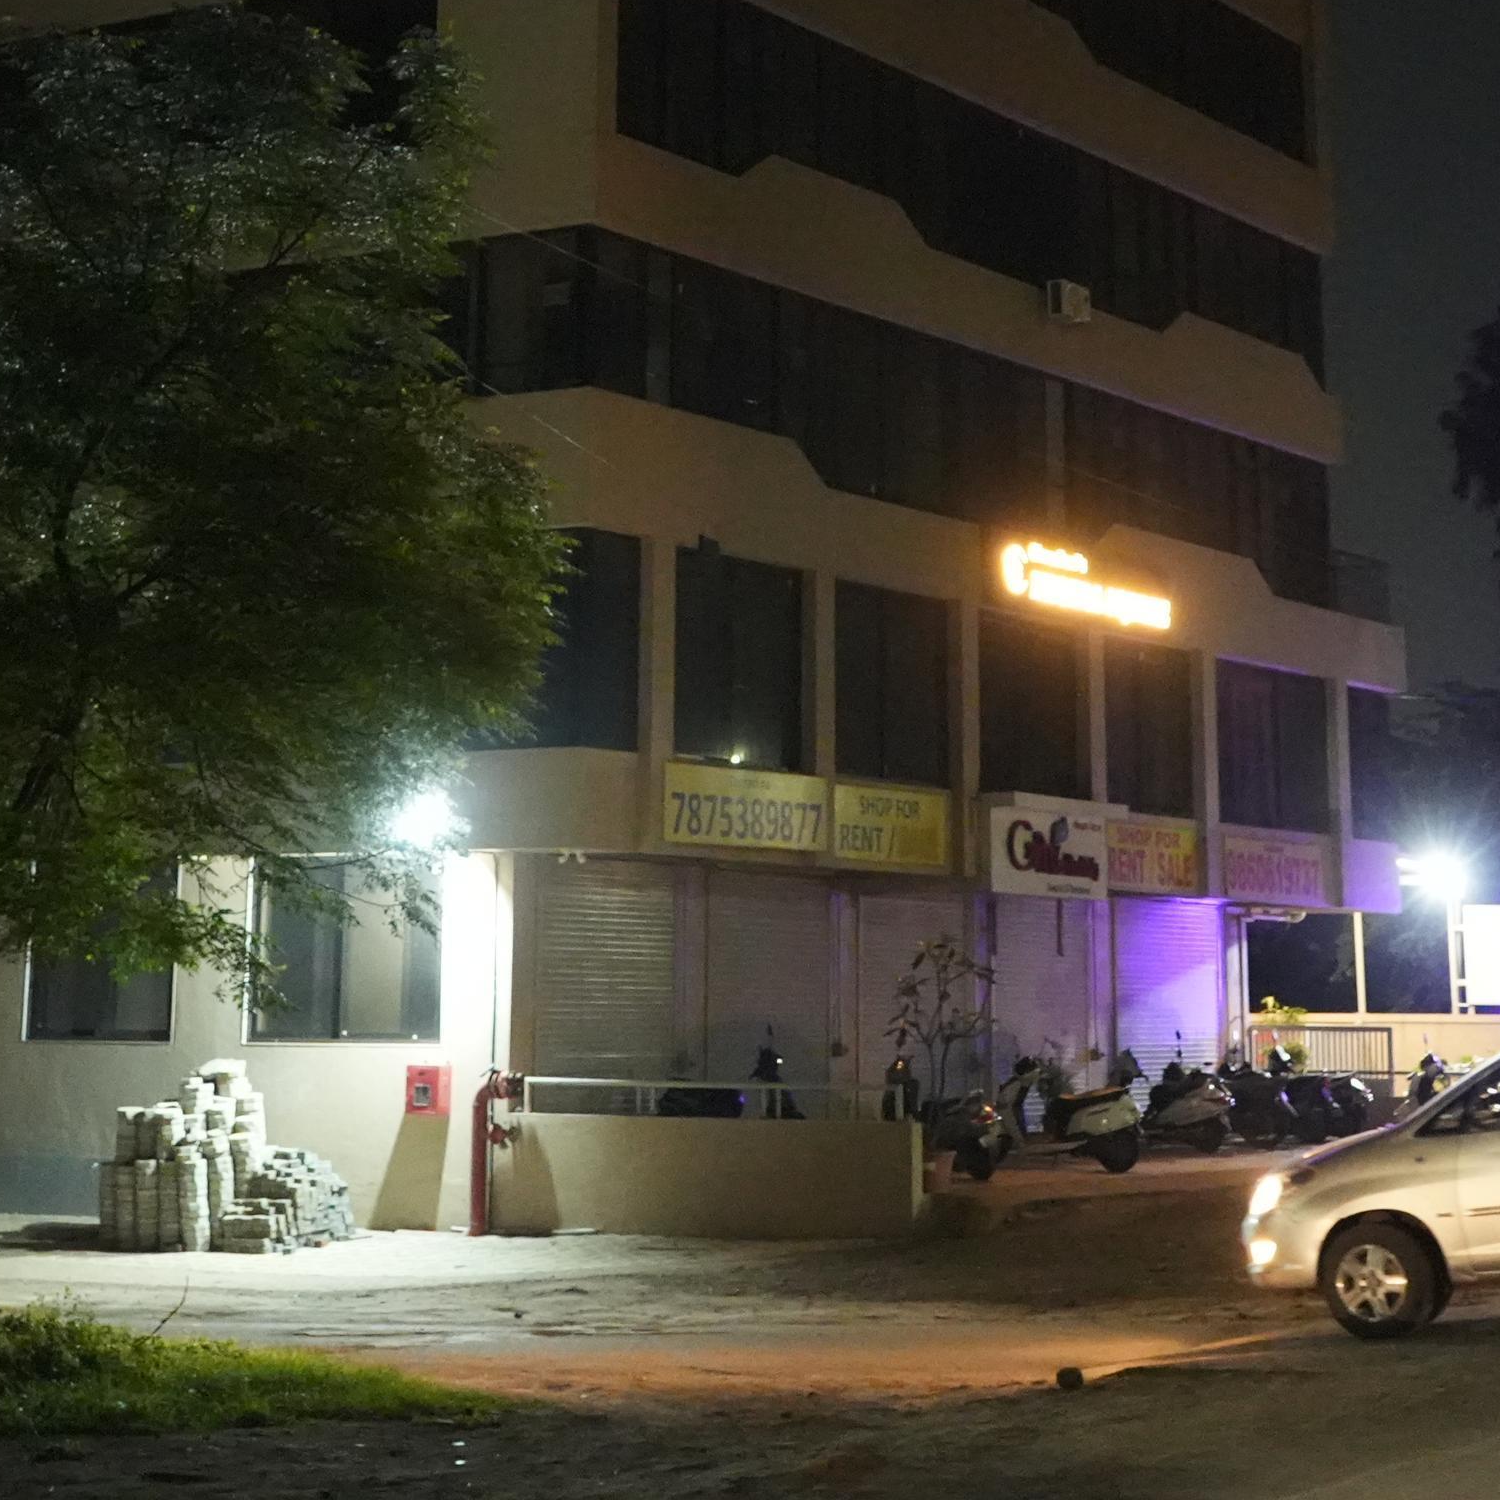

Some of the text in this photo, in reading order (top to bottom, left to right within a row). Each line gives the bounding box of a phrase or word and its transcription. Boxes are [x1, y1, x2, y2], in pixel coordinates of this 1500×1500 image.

[671, 791, 822, 844] 7875389877
[859, 795, 920, 820] SHOP FOR
[840, 823, 884, 854] RENT
[1116, 825, 1152, 847] SHOP
[1155, 830, 1181, 850] FOR
[1107, 847, 1146, 884] RENT
[1157, 852, 1194, 888] SALE
